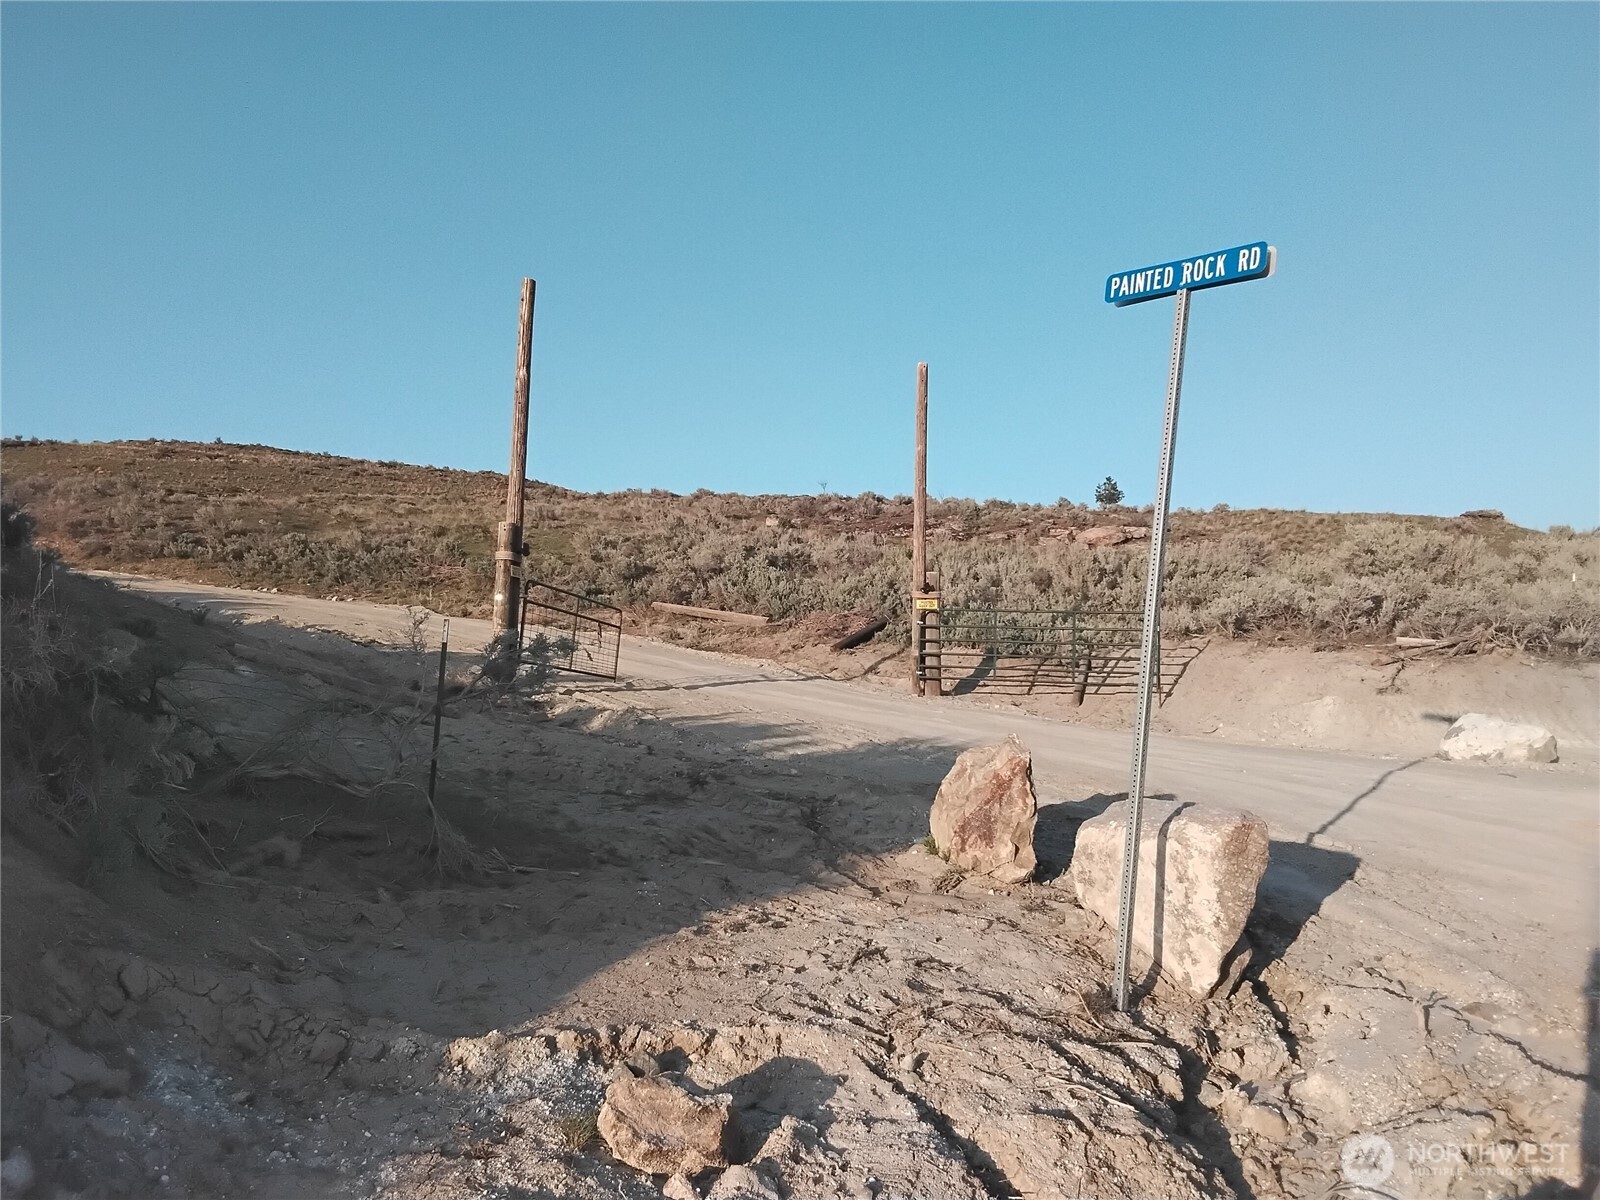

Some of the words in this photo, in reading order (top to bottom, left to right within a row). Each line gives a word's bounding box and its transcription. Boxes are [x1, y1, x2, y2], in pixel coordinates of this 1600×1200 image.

[1110, 266, 1174, 298] PAINTED
[1181, 253, 1227, 284] ROCK
[1238, 246, 1260, 272] RD
